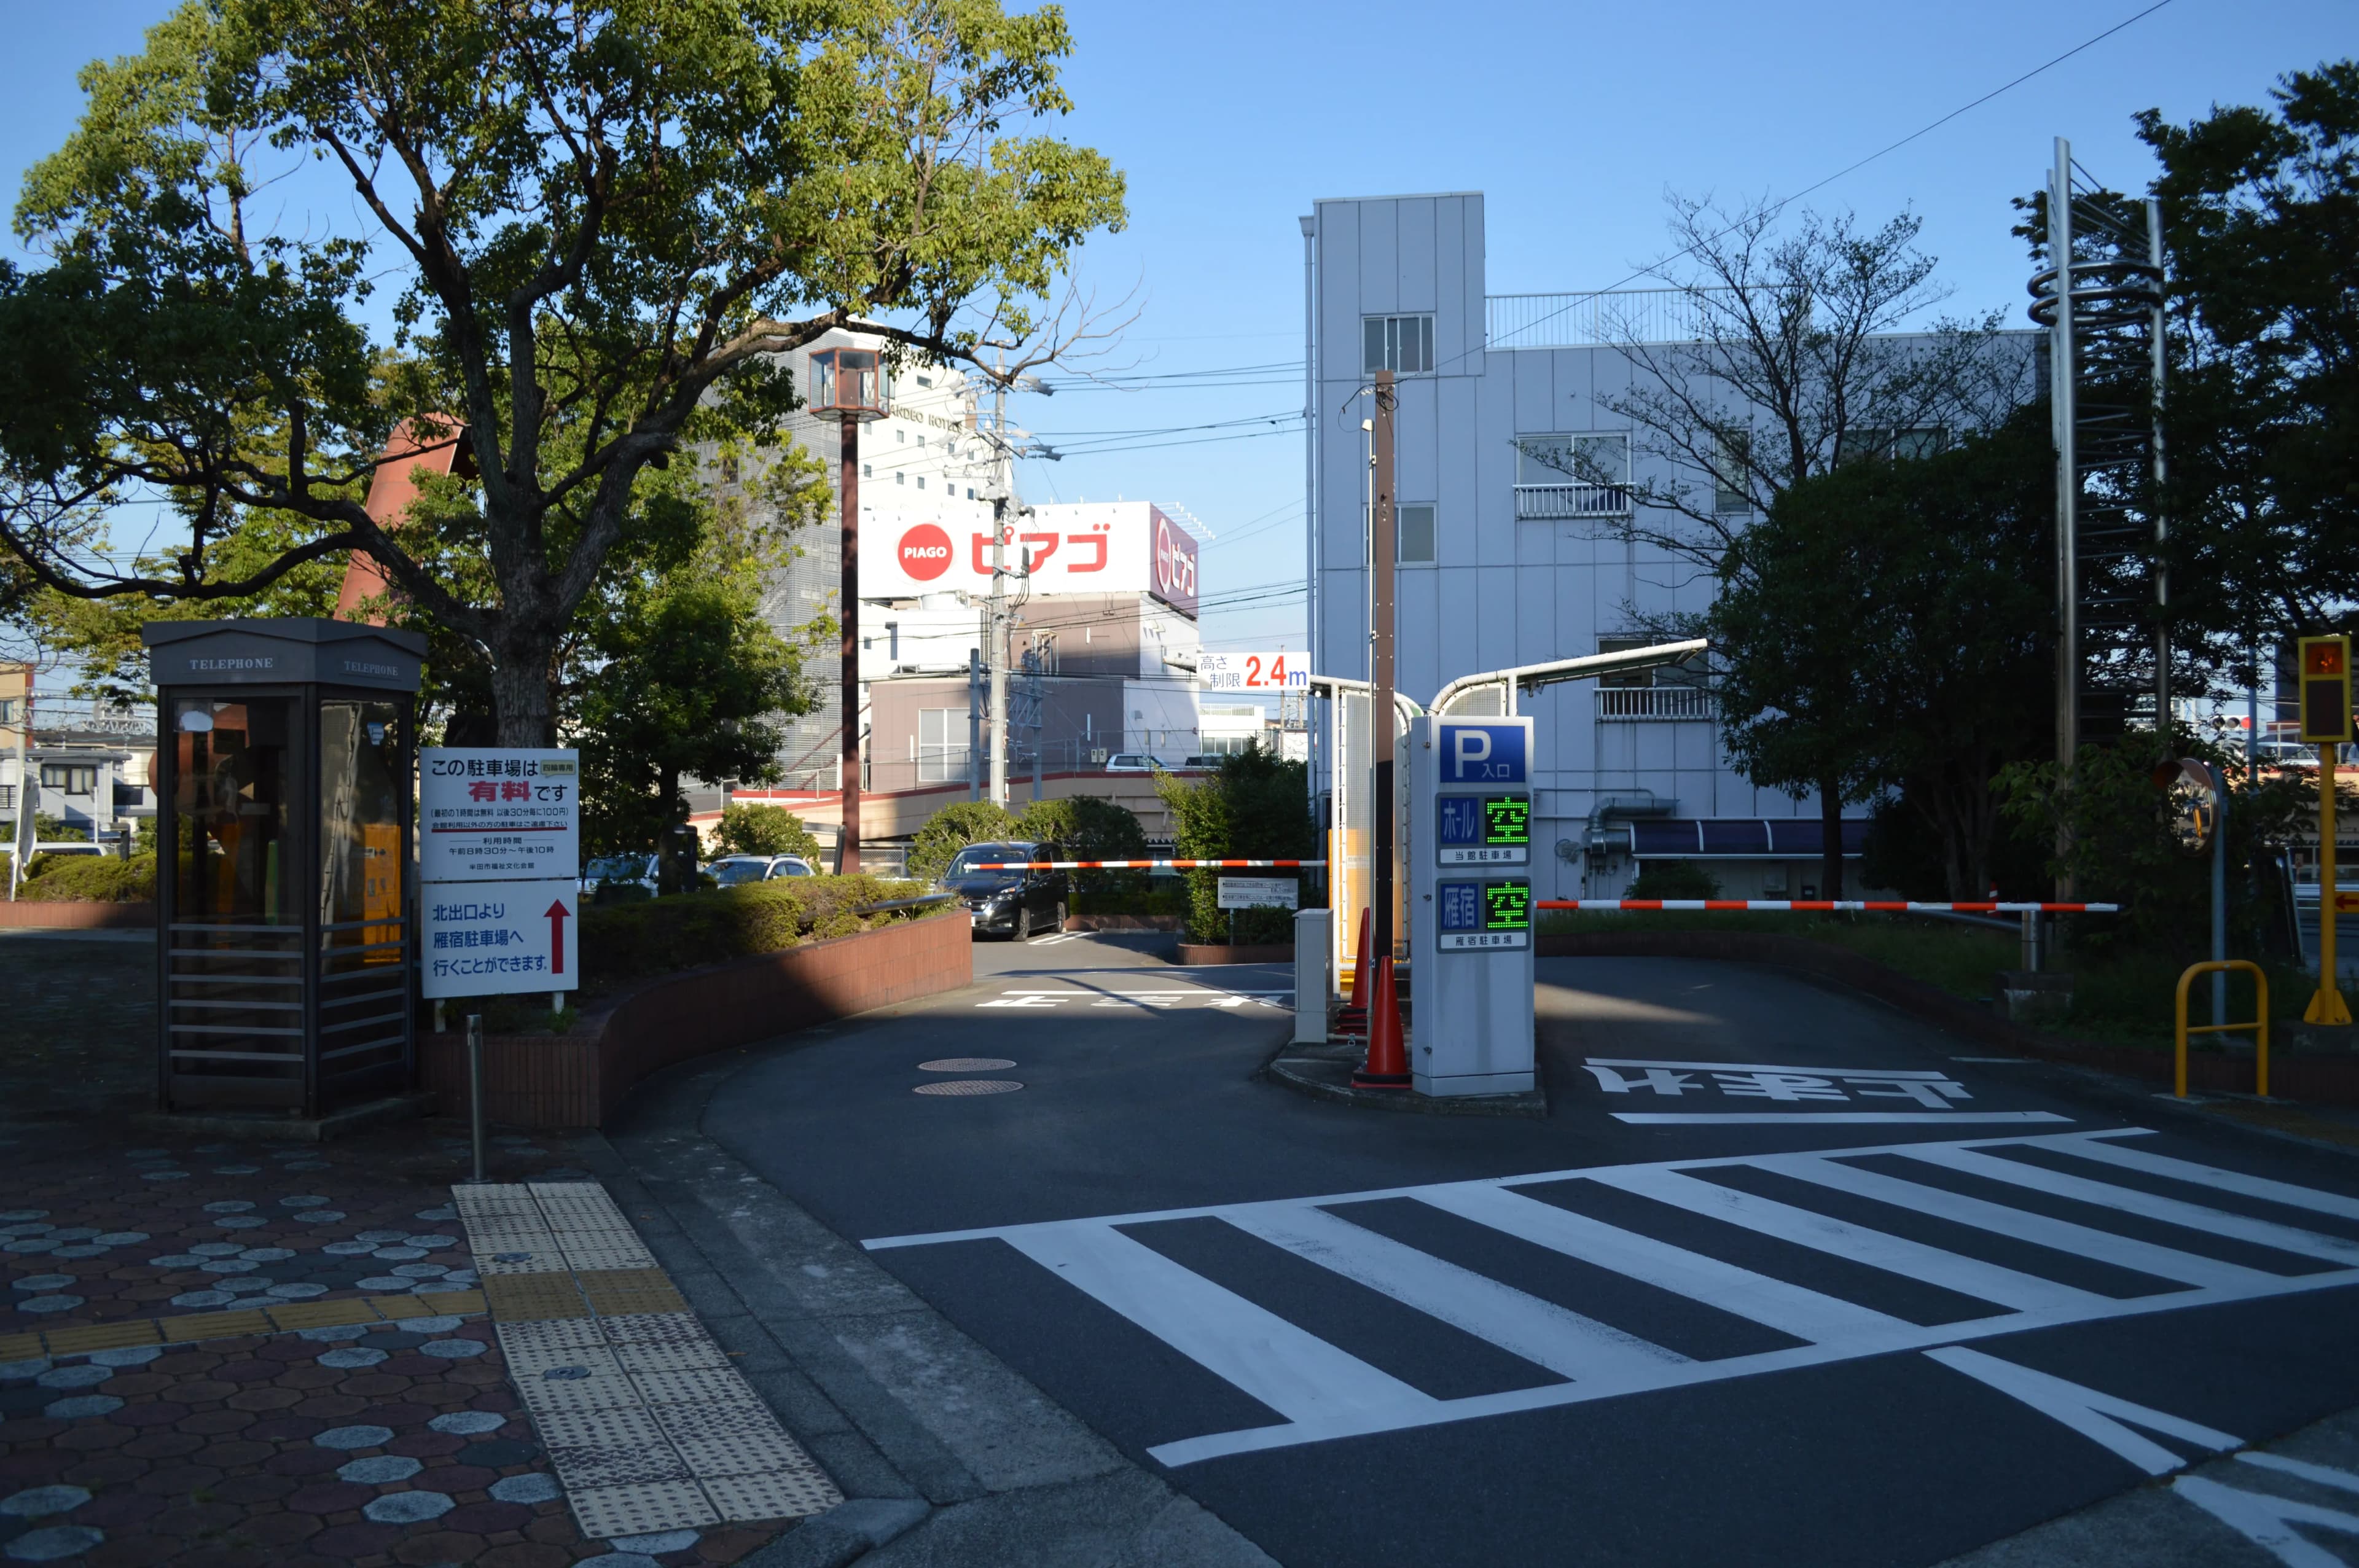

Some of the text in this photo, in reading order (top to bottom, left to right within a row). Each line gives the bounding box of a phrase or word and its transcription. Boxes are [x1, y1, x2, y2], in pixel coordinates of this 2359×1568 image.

[904, 546, 947, 559] PIAGO
[972, 523, 1111, 575] ピアゴ
[1172, 543, 1195, 598] ピアゴ
[189, 658, 273, 670] TELEPHONE
[343, 660, 399, 676] TELEPHONE
[1200, 655, 1227, 671] 高さ
[1245, 655, 1307, 687] 2.4m
[1210, 673, 1241, 688] 制限
[1455, 730, 1492, 778] P
[432, 759, 539, 777] この駐車場は
[542, 763, 574, 772] 四輪専用
[1482, 763, 1510, 779] 入口
[468, 781, 568, 802] 有料です
[1444, 800, 1475, 840] ホール
[1487, 797, 1528, 843] 空
[1455, 850, 1512, 861] 当館駐車場
[432, 903, 505, 921] 北出口より
[1444, 886, 1476, 929] 雁宿
[1487, 881, 1529, 929] 空
[433, 929, 524, 949] 雁宿駐車場へ
[1455, 935, 1512, 946] 雁宿駐車場
[1581, 1064, 1973, 1109] 止まれ
